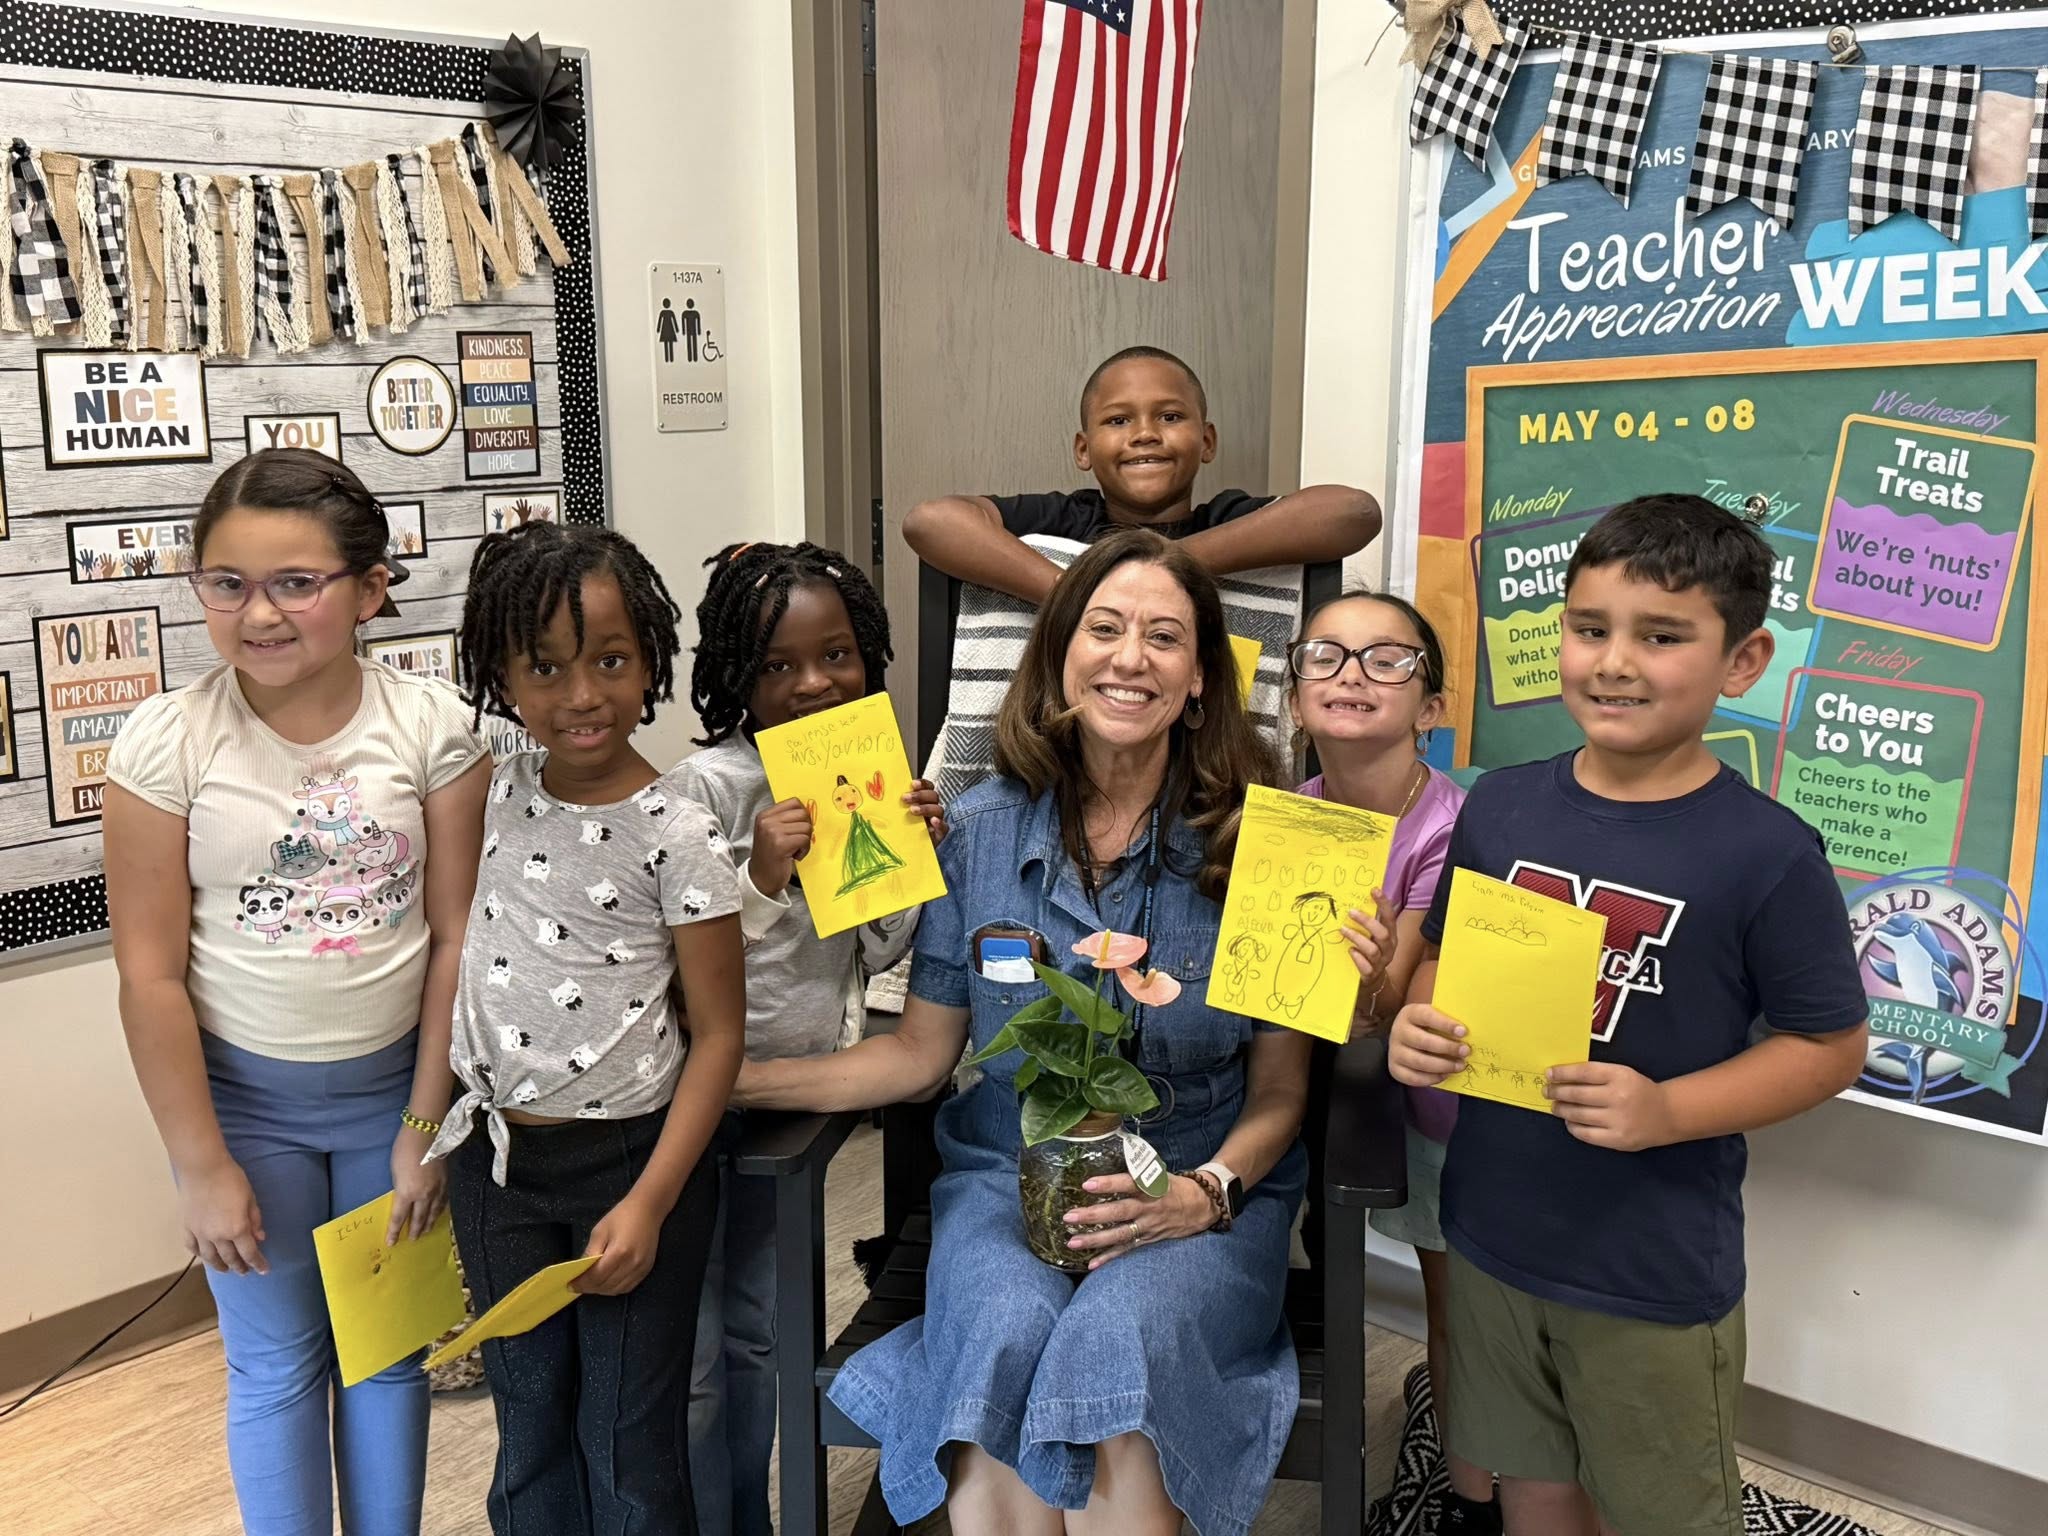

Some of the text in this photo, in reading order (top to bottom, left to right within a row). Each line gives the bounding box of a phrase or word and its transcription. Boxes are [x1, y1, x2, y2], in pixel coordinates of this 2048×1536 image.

[1506, 196, 1780, 293] Teacher
[672, 272, 703, 284] 1-137A
[1788, 244, 2048, 329] WEEK
[1482, 276, 1783, 363] Appreciation
[85, 362, 163, 384] BE A
[387, 378, 434, 404] BETTER
[74, 388, 178, 424] NICE
[663, 392, 723, 405] RESTROOM
[1871, 388, 2009, 438] Wednesday
[262, 422, 326, 449] YOU
[380, 404, 444, 432] TOGETHER
[1519, 399, 1756, 445] MAY 04 - 08
[66, 425, 191, 451] HUMAN
[1894, 437, 1971, 480] Trail
[1489, 486, 1574, 523] Monday
[1876, 465, 1985, 513] Treats
[117, 524, 191, 549] EVER
[1504, 532, 1587, 573] Donu
[1835, 527, 2001, 582] We're 'nuts'
[1835, 564, 1984, 613] about you!
[50, 617, 149, 666] YOU ARE
[382, 648, 442, 671] ALWAYS
[1506, 646, 1547, 666] what
[1837, 641, 1924, 680] Friday
[56, 677, 150, 707] IMPORTANT
[1814, 692, 1935, 735] Cheers
[1815, 723, 1924, 767] to You
[1798, 767, 1931, 803] Cheers to the
[1794, 787, 1928, 825] teachers who
[1820, 817, 1892, 841] make a
[1823, 835, 1908, 867] ference!
[1943, 902, 2005, 1021] ADAMS
[1869, 1018, 1953, 1048] CHOOL
[1872, 1001, 1990, 1043] MENTARY
